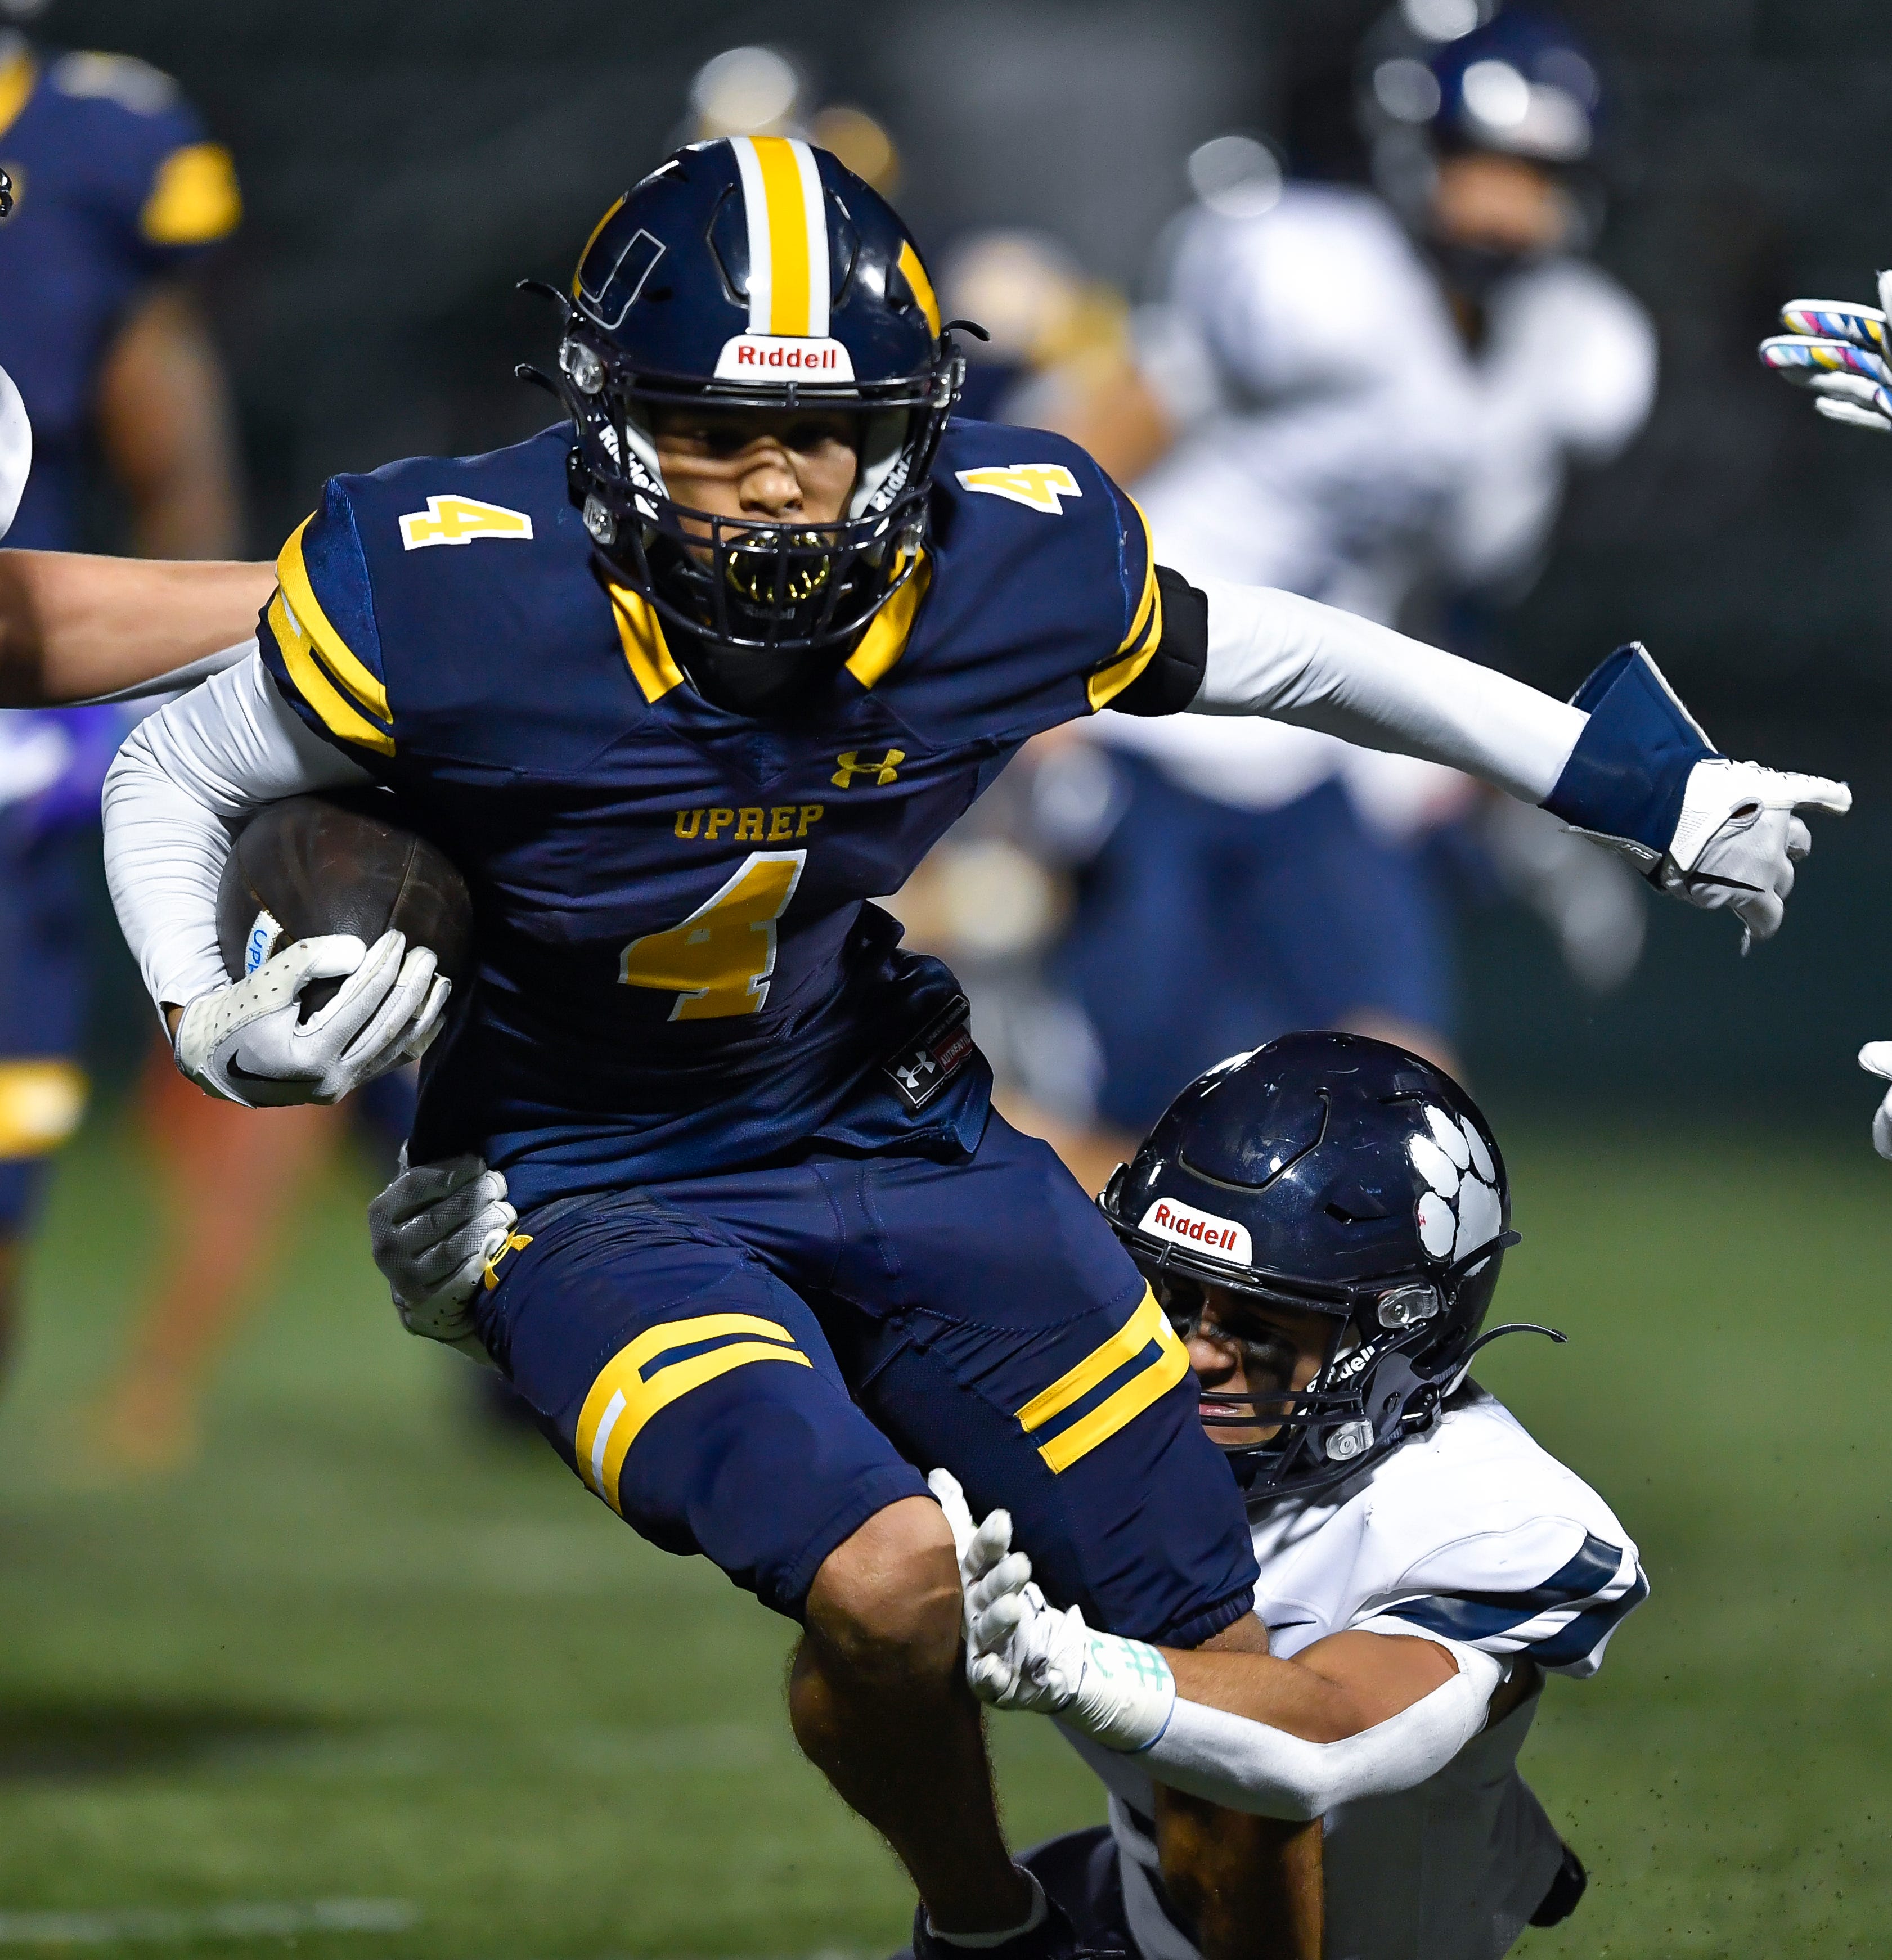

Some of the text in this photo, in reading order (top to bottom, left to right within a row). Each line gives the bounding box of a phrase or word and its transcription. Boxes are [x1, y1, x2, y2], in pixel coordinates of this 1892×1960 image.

[738, 345, 836, 369] Riddell
[955, 463, 1082, 515] 4
[399, 495, 533, 551] 4
[675, 804, 824, 841] UPREP
[617, 849, 807, 1022] 4
[1154, 1203, 1237, 1251] Riddell
